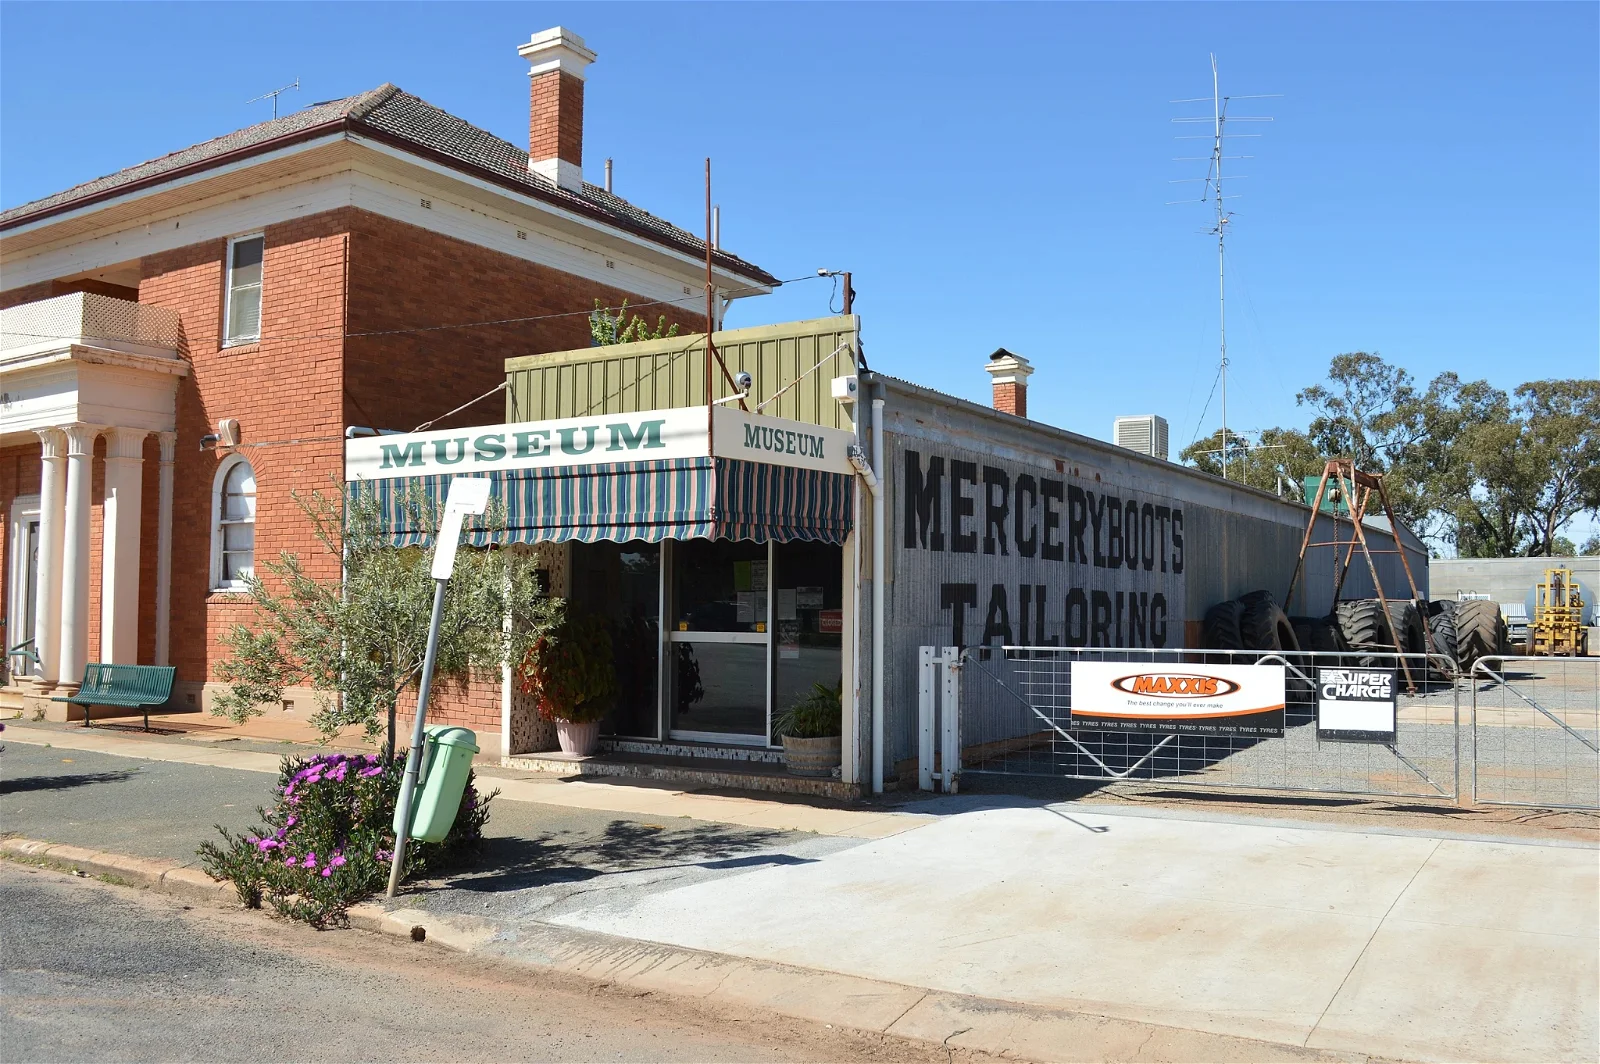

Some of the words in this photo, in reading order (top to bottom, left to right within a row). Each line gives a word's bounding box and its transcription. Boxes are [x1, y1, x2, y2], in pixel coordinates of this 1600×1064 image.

[379, 419, 666, 469] MUSEUM
[743, 422, 825, 459] MUSEUM
[941, 583, 1167, 662] TAILORING
[1132, 677, 1218, 694] MAXXIS
[1340, 670, 1392, 685] SUPER
[1322, 684, 1392, 700] CHARGE
